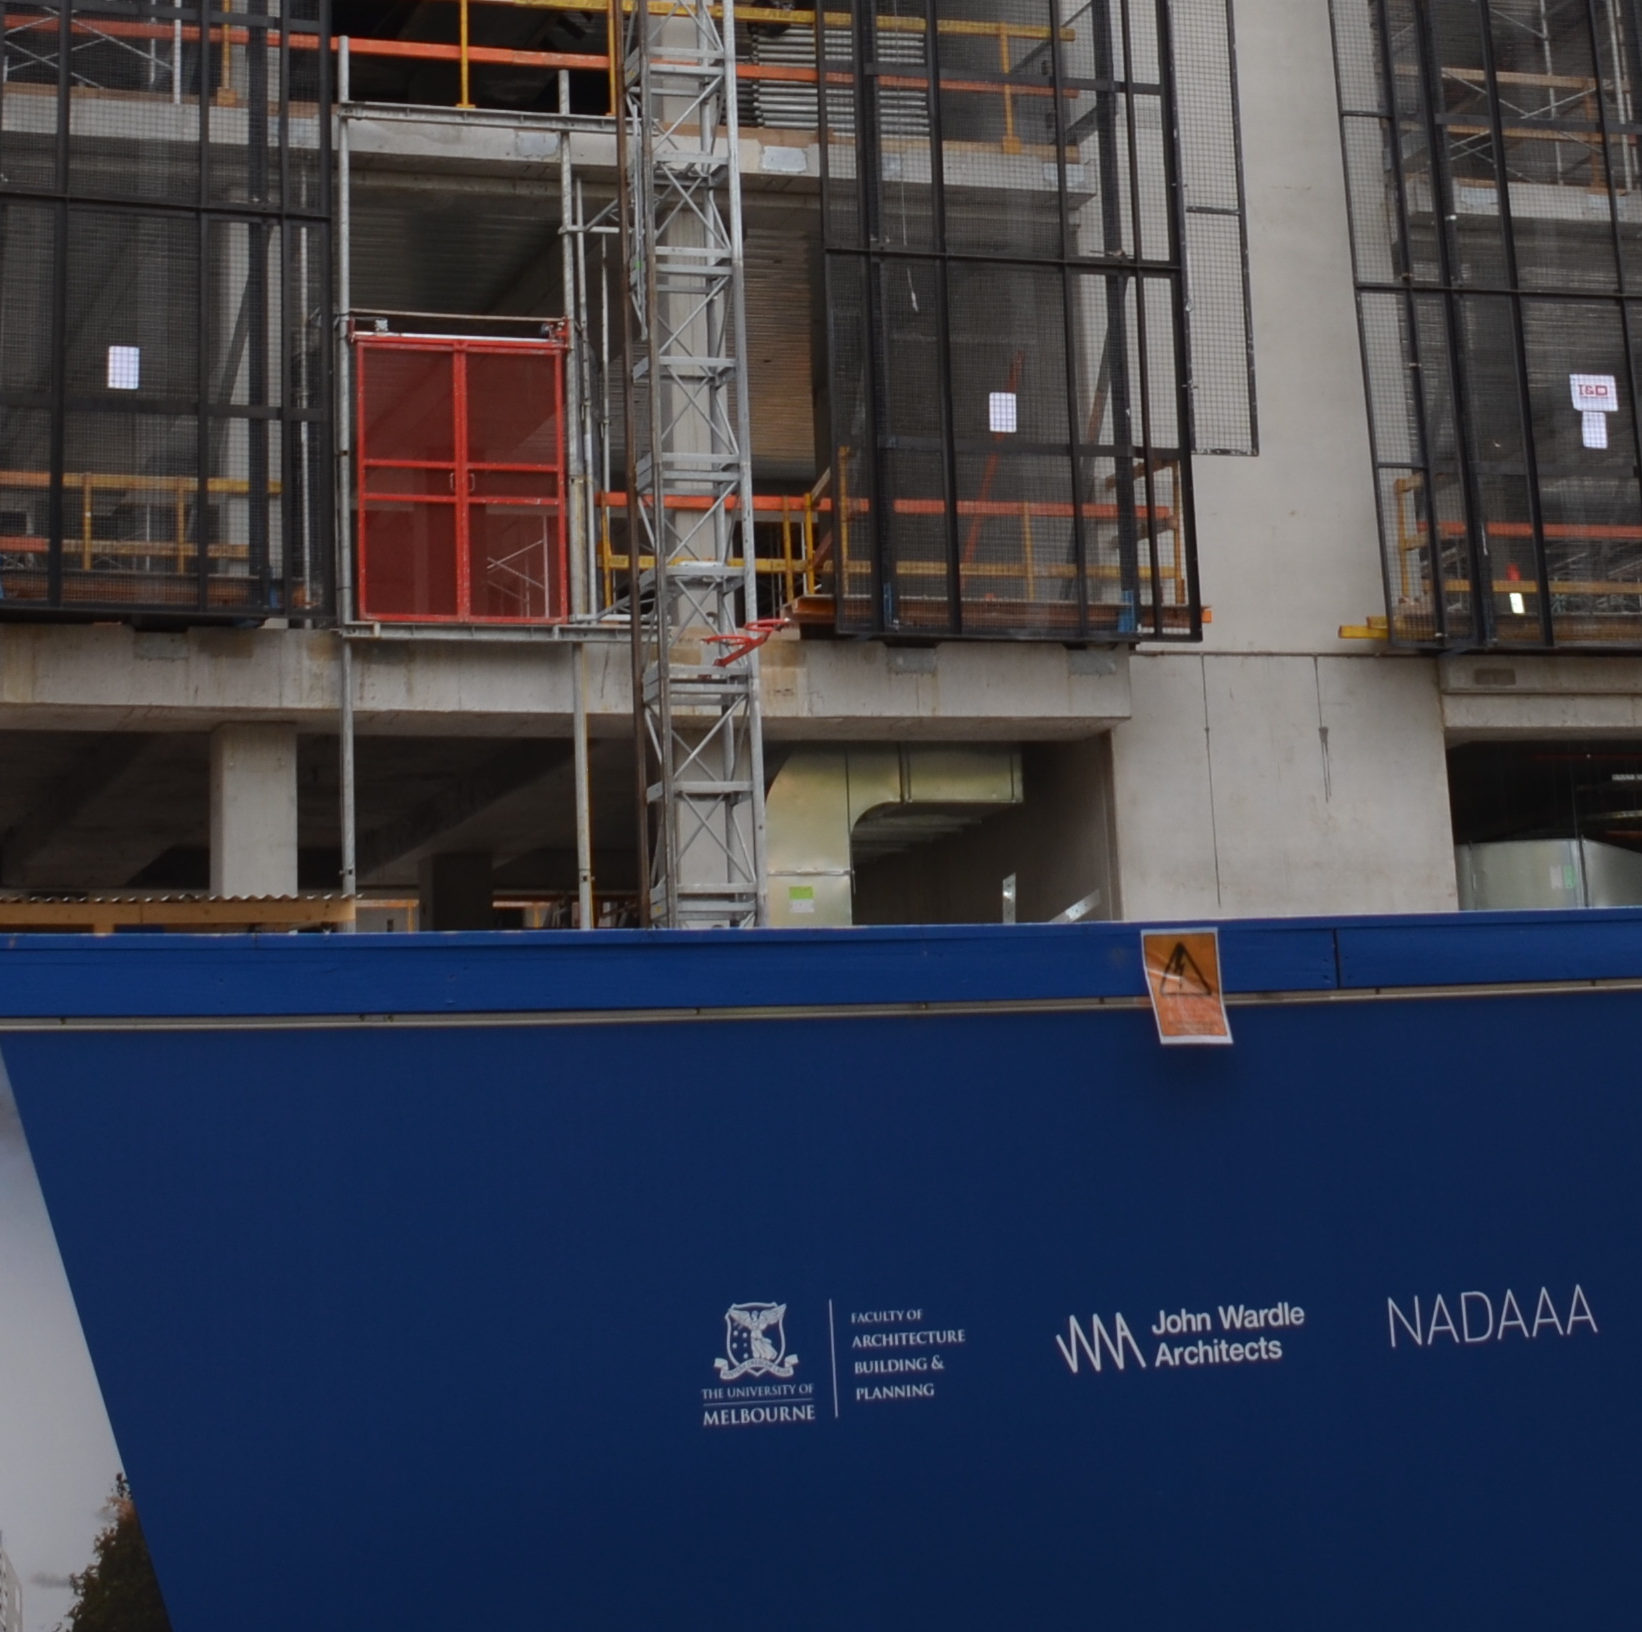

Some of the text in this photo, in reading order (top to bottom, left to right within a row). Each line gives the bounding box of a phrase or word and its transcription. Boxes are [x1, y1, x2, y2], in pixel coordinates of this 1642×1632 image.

[851, 1309, 923, 1324] FACULTY OF
[1151, 1301, 1306, 1334] John Wardle
[1387, 1283, 1599, 1348] NADAAA
[851, 1329, 966, 1348] ARCHITECTURE
[1155, 1336, 1283, 1368] Architects
[854, 1354, 945, 1375] BUILDING &
[701, 1383, 814, 1400] THE UNIVERSITY OF
[856, 1383, 935, 1401] PLANNING
[703, 1404, 816, 1426] MELBOURNE
